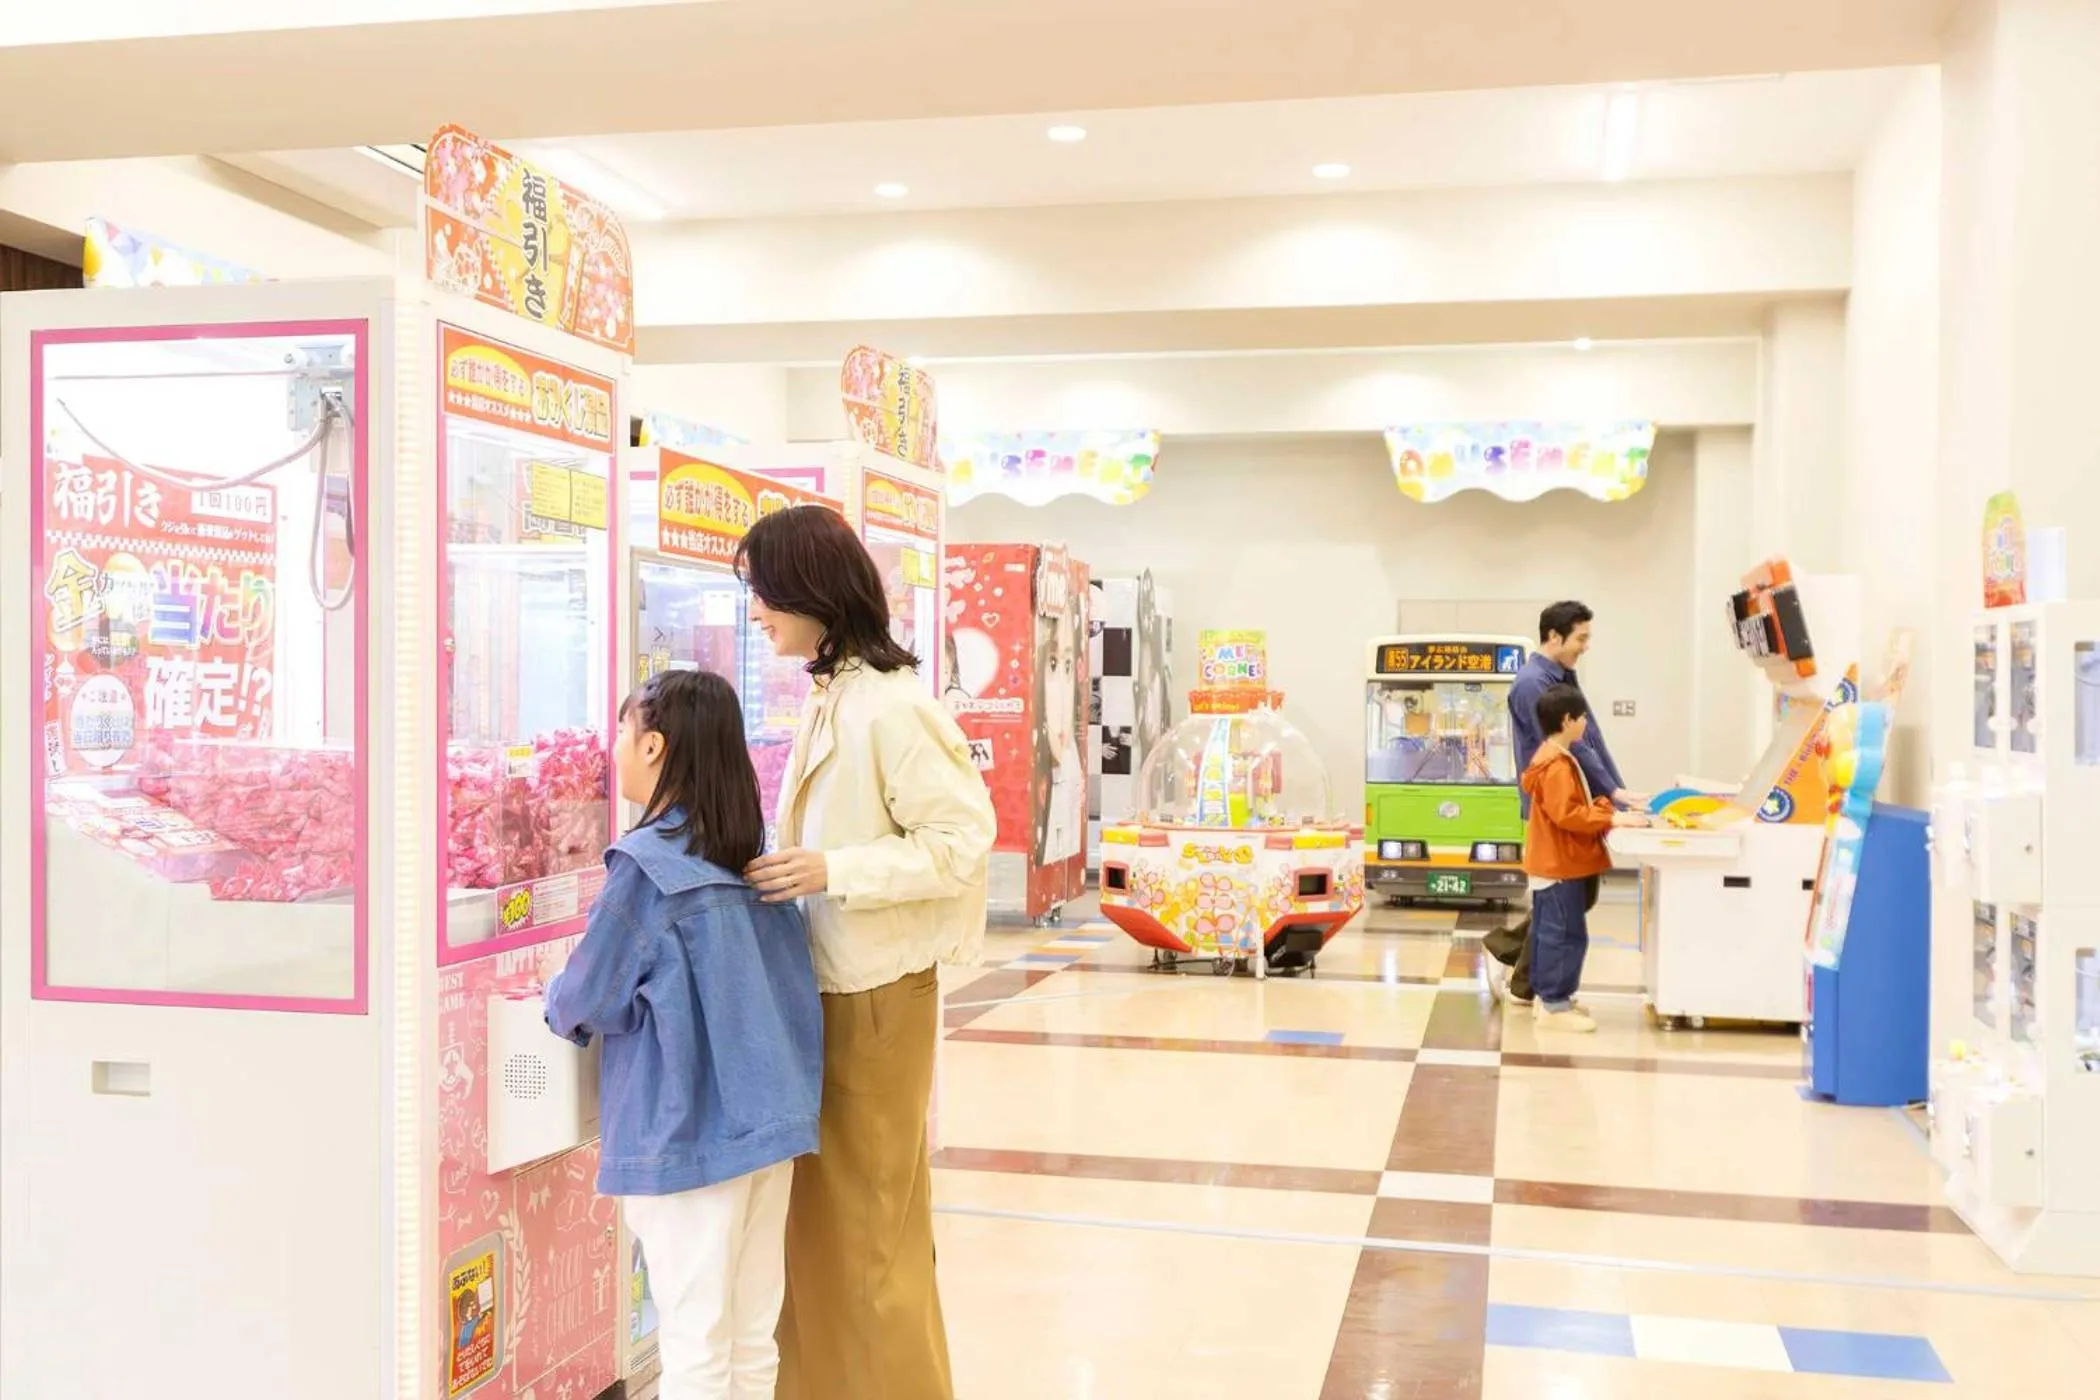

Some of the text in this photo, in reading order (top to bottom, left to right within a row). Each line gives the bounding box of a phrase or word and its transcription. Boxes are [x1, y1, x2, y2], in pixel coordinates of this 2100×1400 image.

[522, 168, 547, 319] 福引き
[897, 363, 911, 457] 福引き
[52, 462, 162, 528] 福引き
[198, 491, 268, 517] 1回100円
[149, 560, 274, 646] 当たり
[145, 657, 273, 729] 確定!?
[1204, 662, 1264, 678] CORNER
[1409, 653, 1492, 671] アイランド空港
